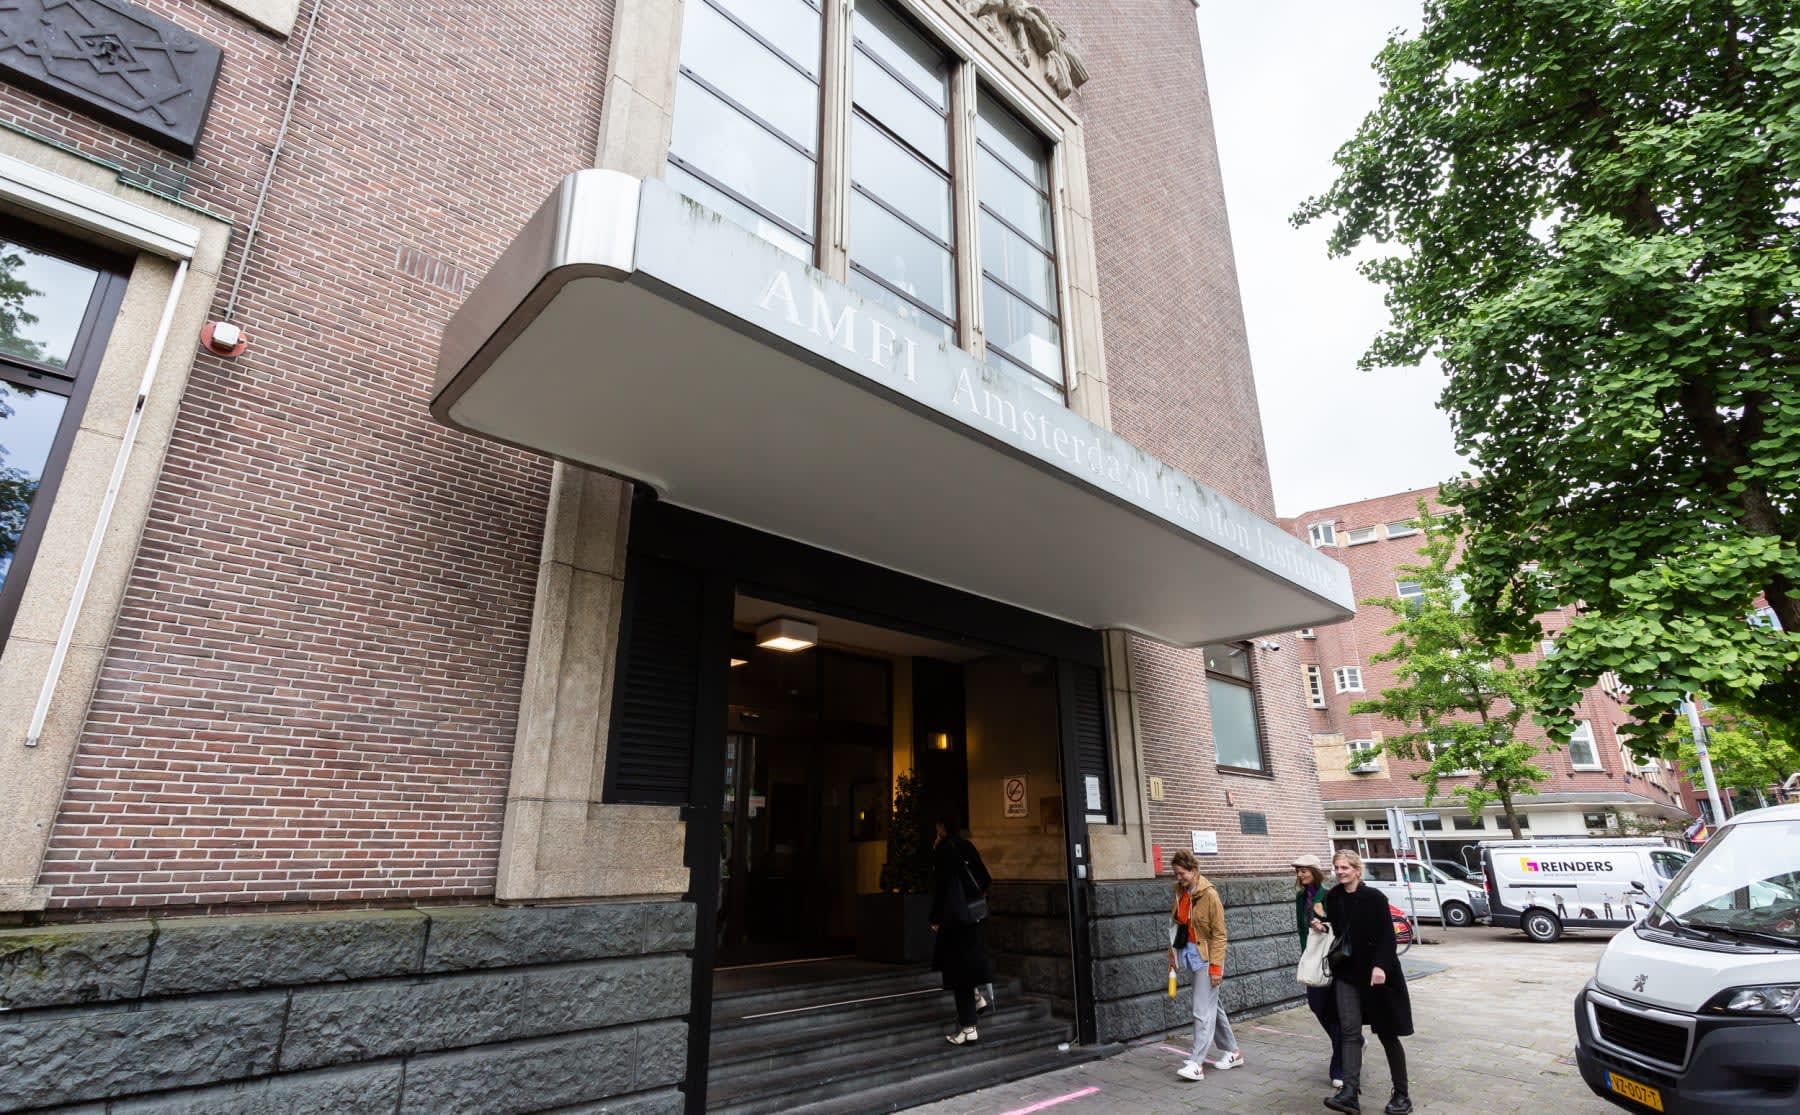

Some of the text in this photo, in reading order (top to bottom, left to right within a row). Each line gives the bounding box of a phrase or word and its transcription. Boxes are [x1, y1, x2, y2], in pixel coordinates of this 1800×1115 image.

[757, 270, 919, 384] AMFI
[952, 367, 1154, 501] Amsterdam
[1540, 860, 1614, 873] REINDERS
